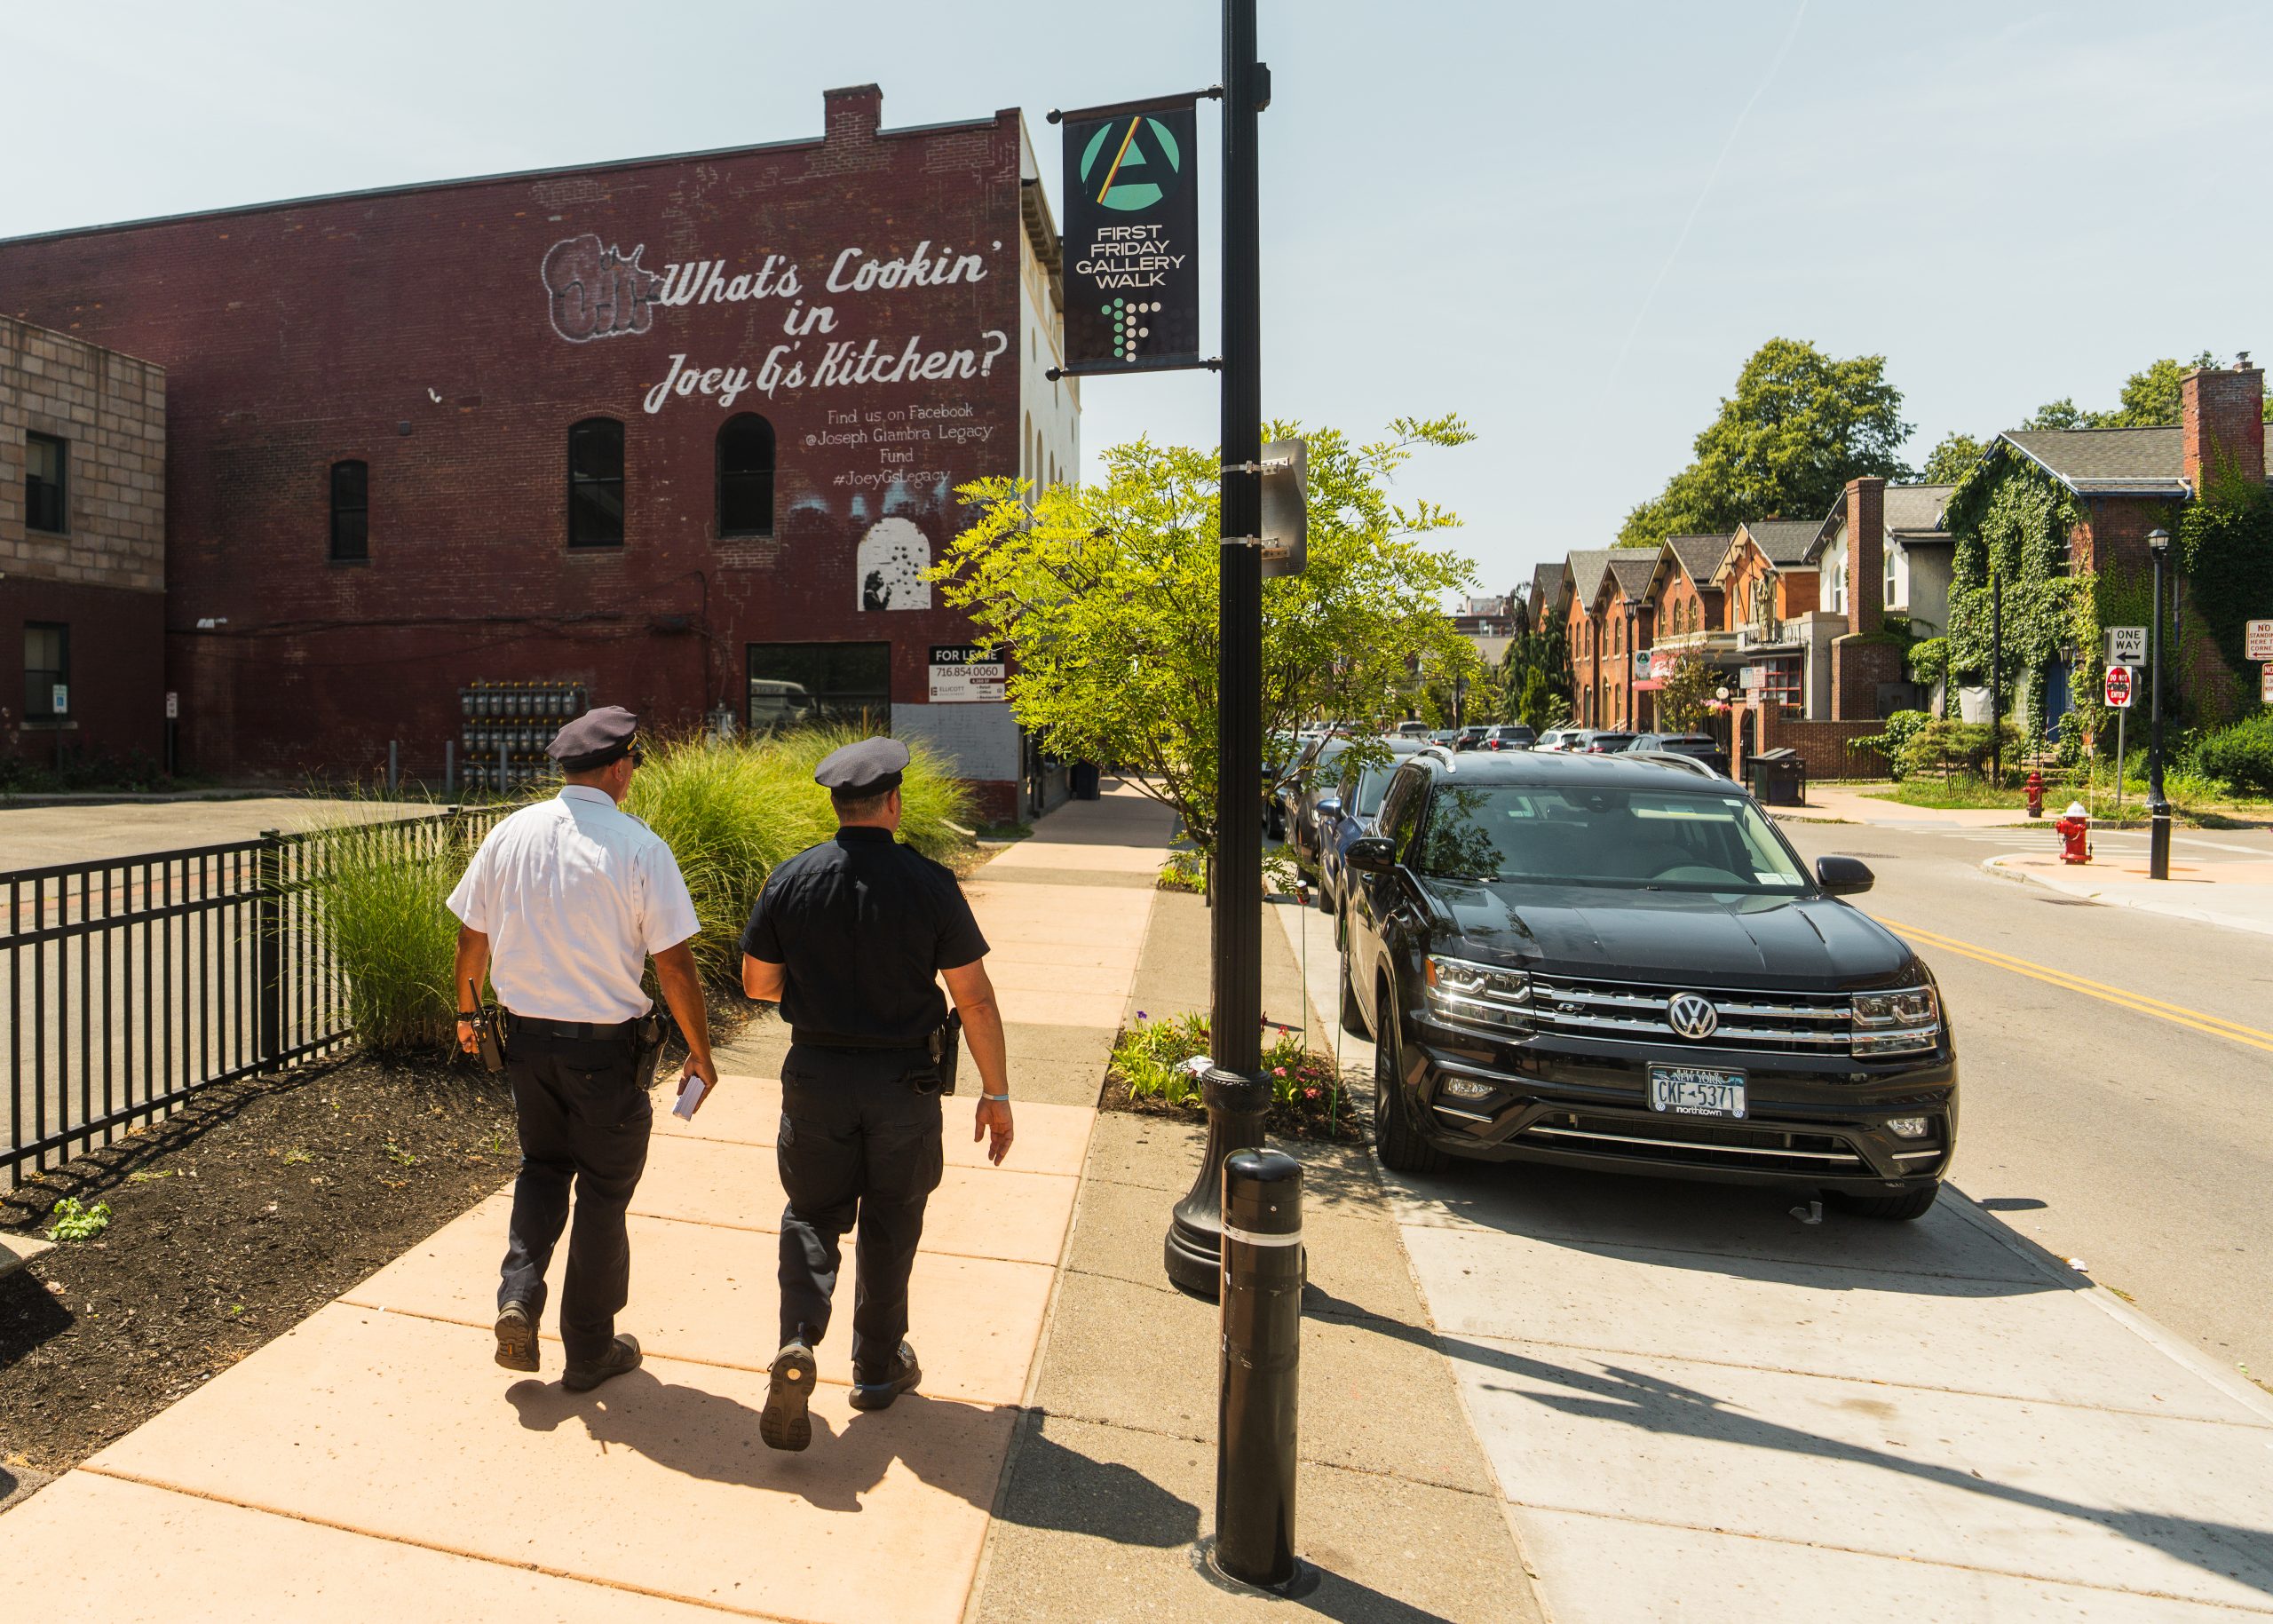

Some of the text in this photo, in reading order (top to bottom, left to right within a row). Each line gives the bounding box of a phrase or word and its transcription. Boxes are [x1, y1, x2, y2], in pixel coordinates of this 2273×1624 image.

[1097, 225, 1162, 242] FIRST
[1091, 241, 1169, 257] FRIDAY
[1076, 255, 1185, 274] GALLERY
[660, 255, 803, 306] What's
[826, 241, 1002, 293] Cookin'
[1095, 272, 1166, 289] WALK
[783, 299, 839, 336] in
[644, 330, 1008, 414] Joey G's Kitchen?
[828, 403, 974, 424] Find us on Facebook
[805, 424, 994, 448] @Joseph Giambra Legacy
[880, 448, 914, 463] Fund
[832, 469, 951, 490] #JoeyGsLegacy
[2117, 630, 2141, 639] ONE
[2116, 641, 2141, 650] WAY
[936, 650, 959, 661] FOR
[937, 667, 998, 677] 716.854.0060
[1673, 1072, 1723, 1084] NEW YORK
[1659, 1081, 1734, 1109] CKF 5371
[1676, 1105, 1723, 1116] northtown
